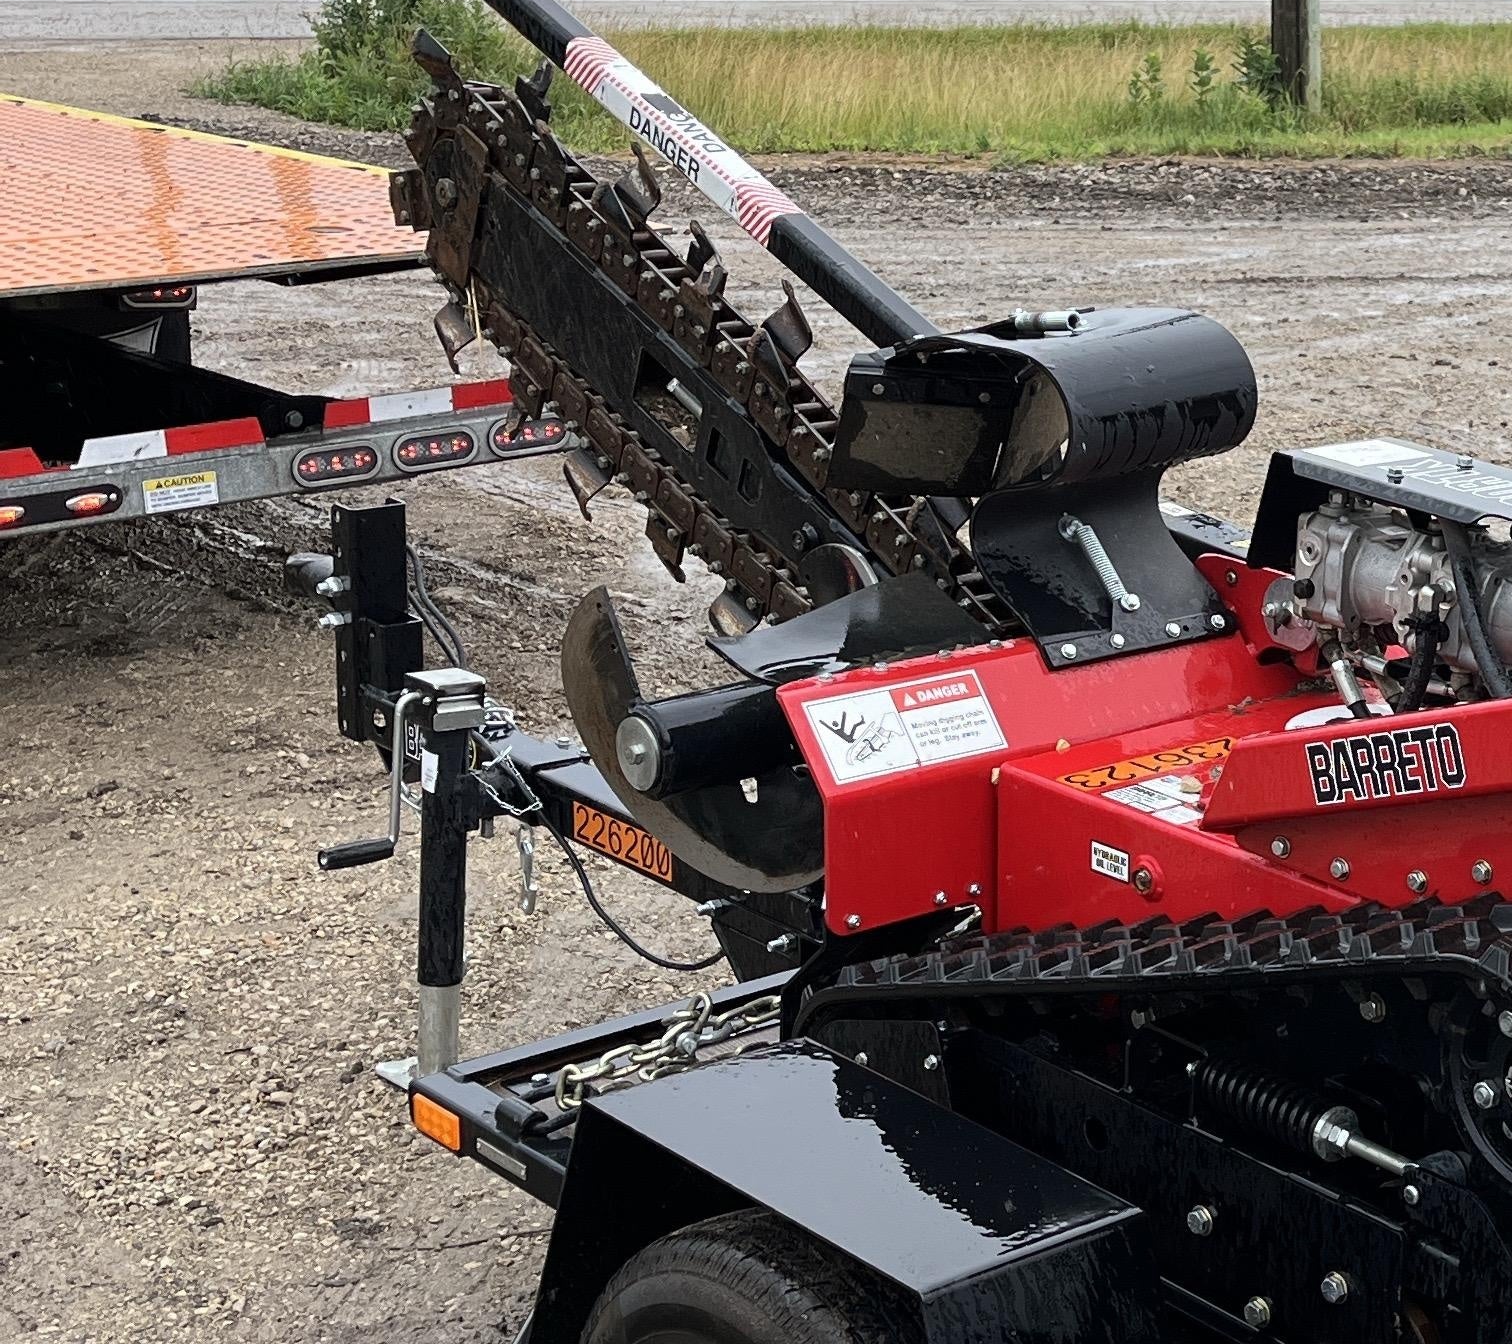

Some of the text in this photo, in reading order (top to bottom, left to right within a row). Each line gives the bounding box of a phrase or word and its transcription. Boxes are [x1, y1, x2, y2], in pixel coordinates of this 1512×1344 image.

[668, 111, 727, 154] DANG
[629, 106, 700, 184] DANGER
[164, 473, 205, 488] CAUTION
[917, 683, 968, 702] DANGER
[911, 720, 938, 730] Moving
[1305, 722, 1467, 806] BARRETO
[576, 804, 670, 876] 226200
[1093, 846, 1127, 866] HYDRAULIC
[1096, 857, 1124, 876] OIL LEVEL
